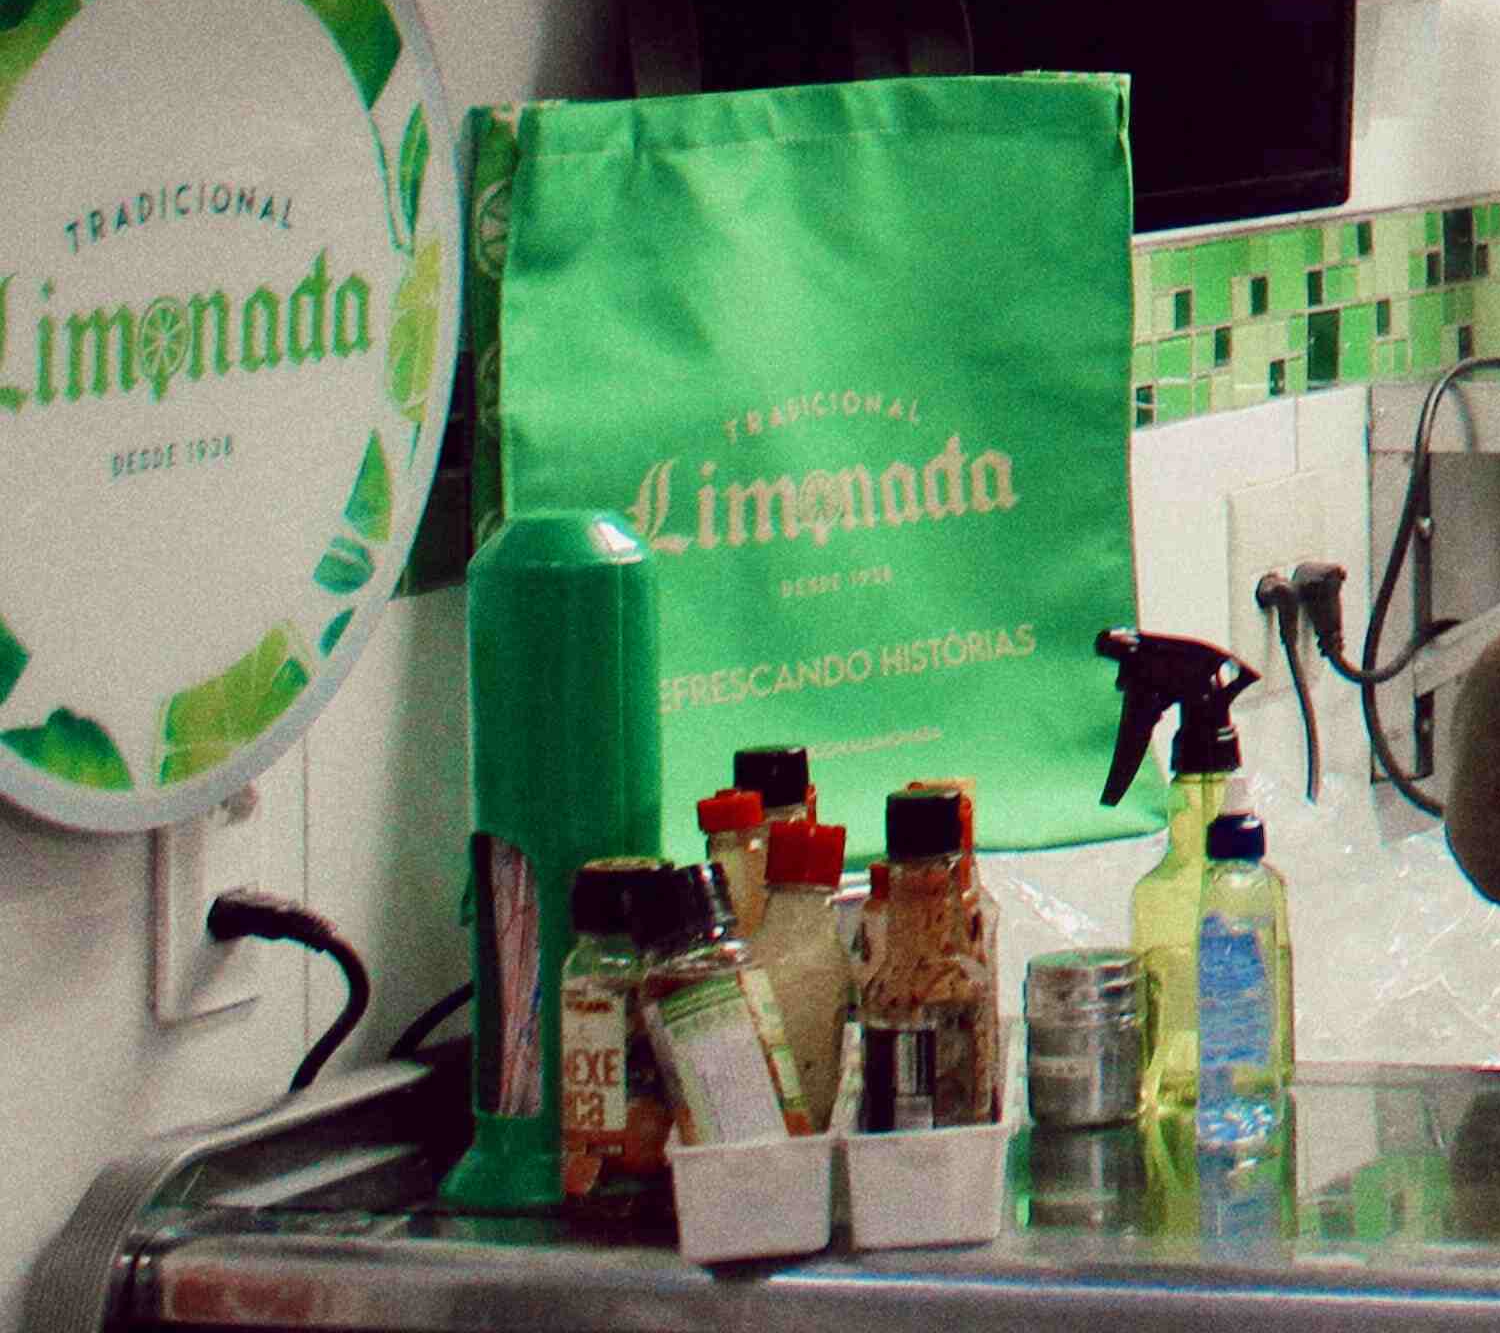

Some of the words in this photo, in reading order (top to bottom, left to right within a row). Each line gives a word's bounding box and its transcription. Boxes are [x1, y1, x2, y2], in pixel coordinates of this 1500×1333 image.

[63, 183, 293, 254] TRADICIONAL
[626, 431, 1020, 556] Limonada
[659, 649, 874, 715] EFRESCANDO
[879, 623, 1037, 676] HISTÓRIAS
